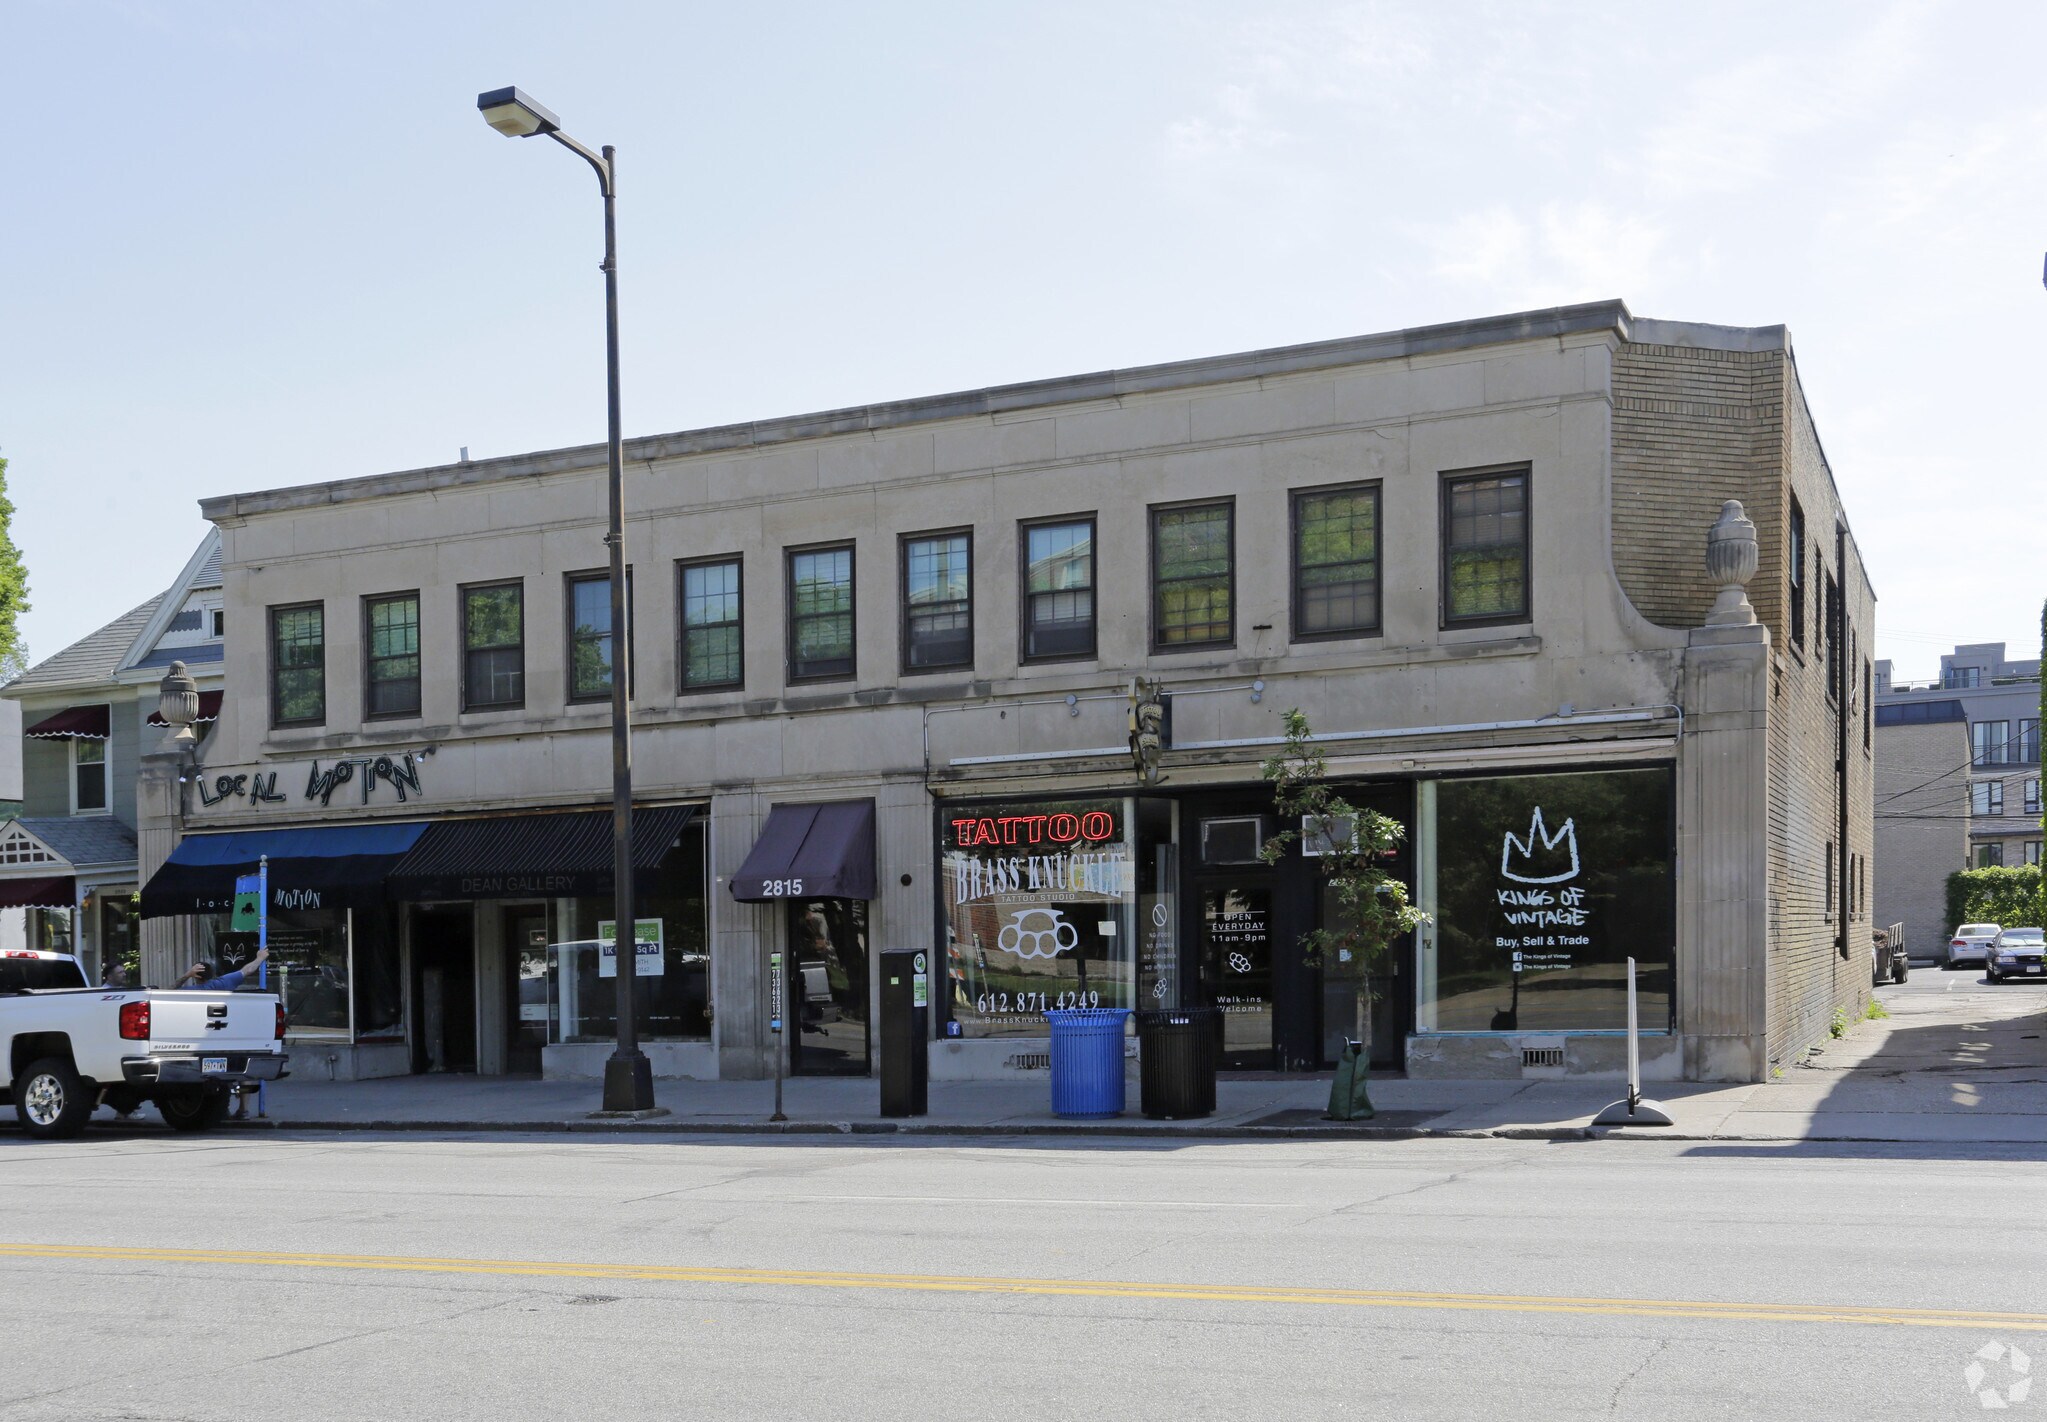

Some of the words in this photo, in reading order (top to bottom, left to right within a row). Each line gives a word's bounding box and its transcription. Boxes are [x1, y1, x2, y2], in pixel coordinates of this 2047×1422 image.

[952, 812, 1113, 847] TATTOO
[462, 877, 501, 893] DEAN
[506, 875, 577, 891] GALLERY
[762, 879, 803, 896] 2815
[956, 857, 1020, 905] BRASS
[1028, 853, 1122, 899] KNUCKLE
[274, 888, 320, 910] MOTION
[1001, 894, 1036, 903] TATTOO
[1040, 893, 1076, 901] STUDIO
[1497, 889, 1555, 906] KINGS
[1560, 886, 1586, 906] OF
[1212, 922, 1264, 930] EVERYDAY
[1504, 908, 1590, 928] VINTAGE
[1212, 934, 1266, 942] 11am-9pm
[1496, 937, 1520, 948] Buy,
[1523, 936, 1543, 946] Sell
[1547, 936, 1555, 946] &
[1558, 935, 1589, 945] Trade
[637, 946, 648, 955] Sq
[978, 991, 1098, 1013] 612.871.4249
